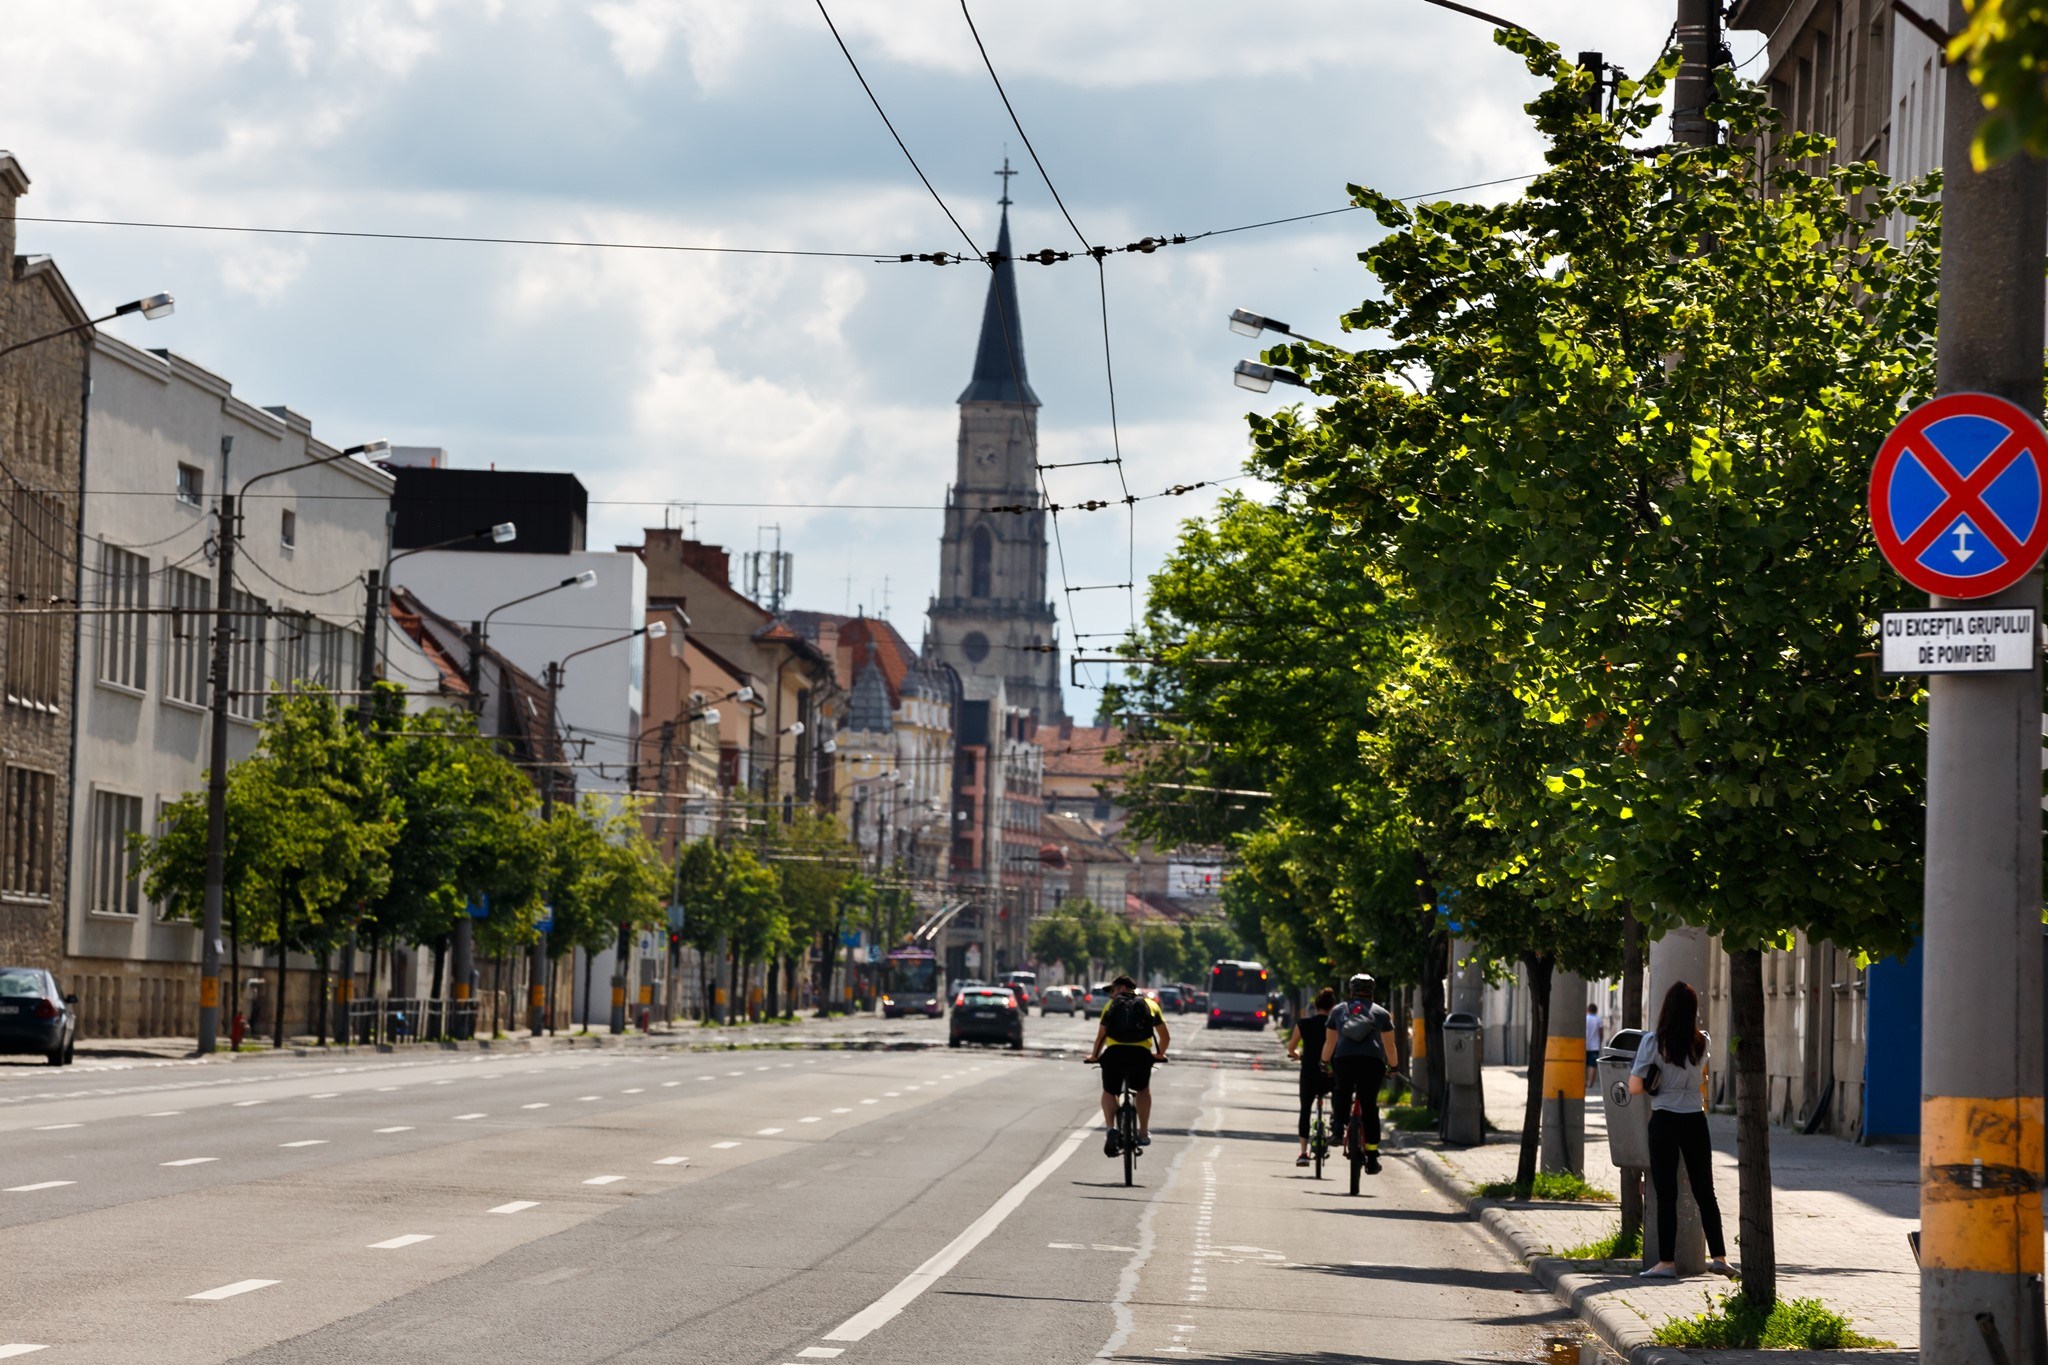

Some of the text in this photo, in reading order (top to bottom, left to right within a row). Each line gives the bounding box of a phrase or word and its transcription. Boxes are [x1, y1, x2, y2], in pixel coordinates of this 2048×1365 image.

[1886, 619, 1902, 637] CU
[1968, 616, 2030, 635] GRUPULUI
[1919, 645, 1996, 664] DE POMPIERI
